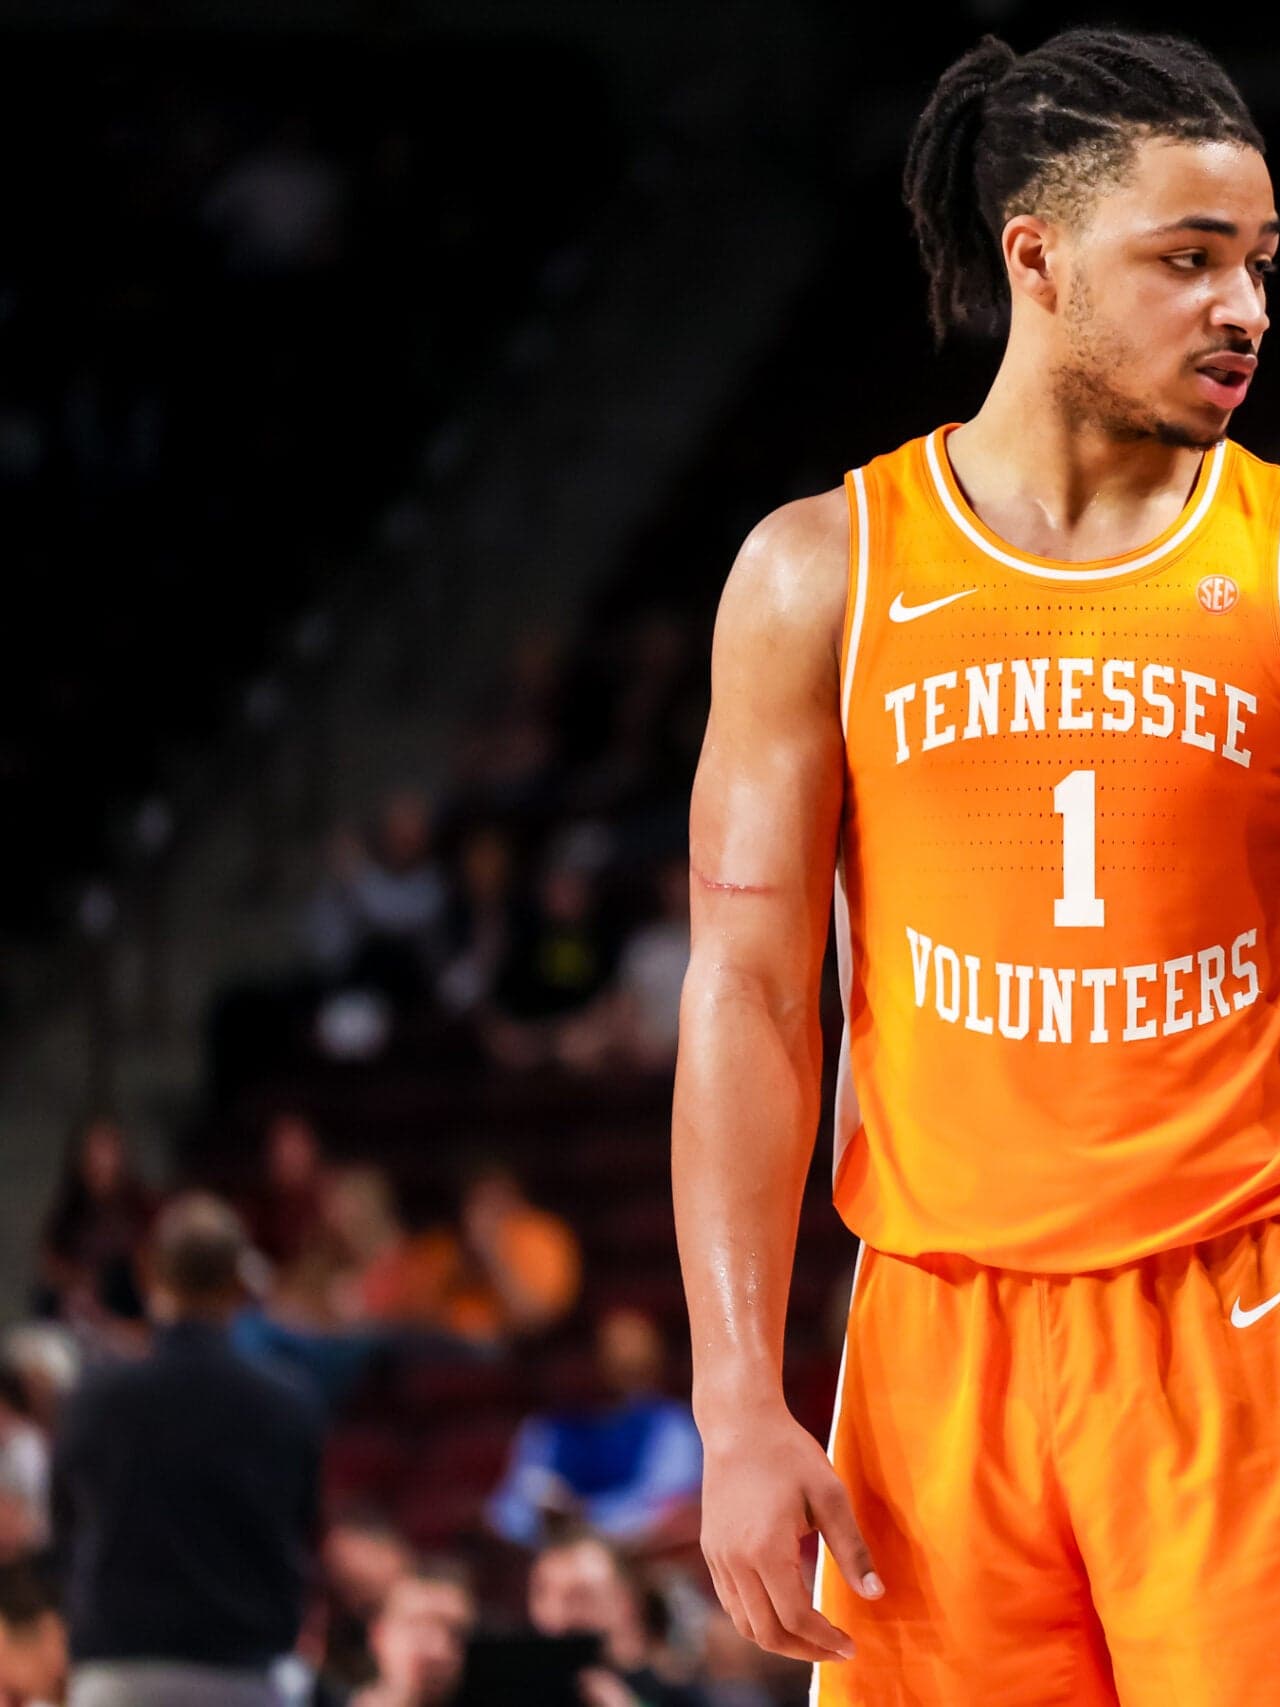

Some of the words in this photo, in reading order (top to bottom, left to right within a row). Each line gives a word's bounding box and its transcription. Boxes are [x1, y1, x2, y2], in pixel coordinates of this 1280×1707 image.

[1199, 577, 1237, 611] SEC
[884, 657, 1258, 769] TENNESSEE
[1053, 769, 1105, 928] 1
[905, 926, 1262, 1044] VOLUNTEERS
